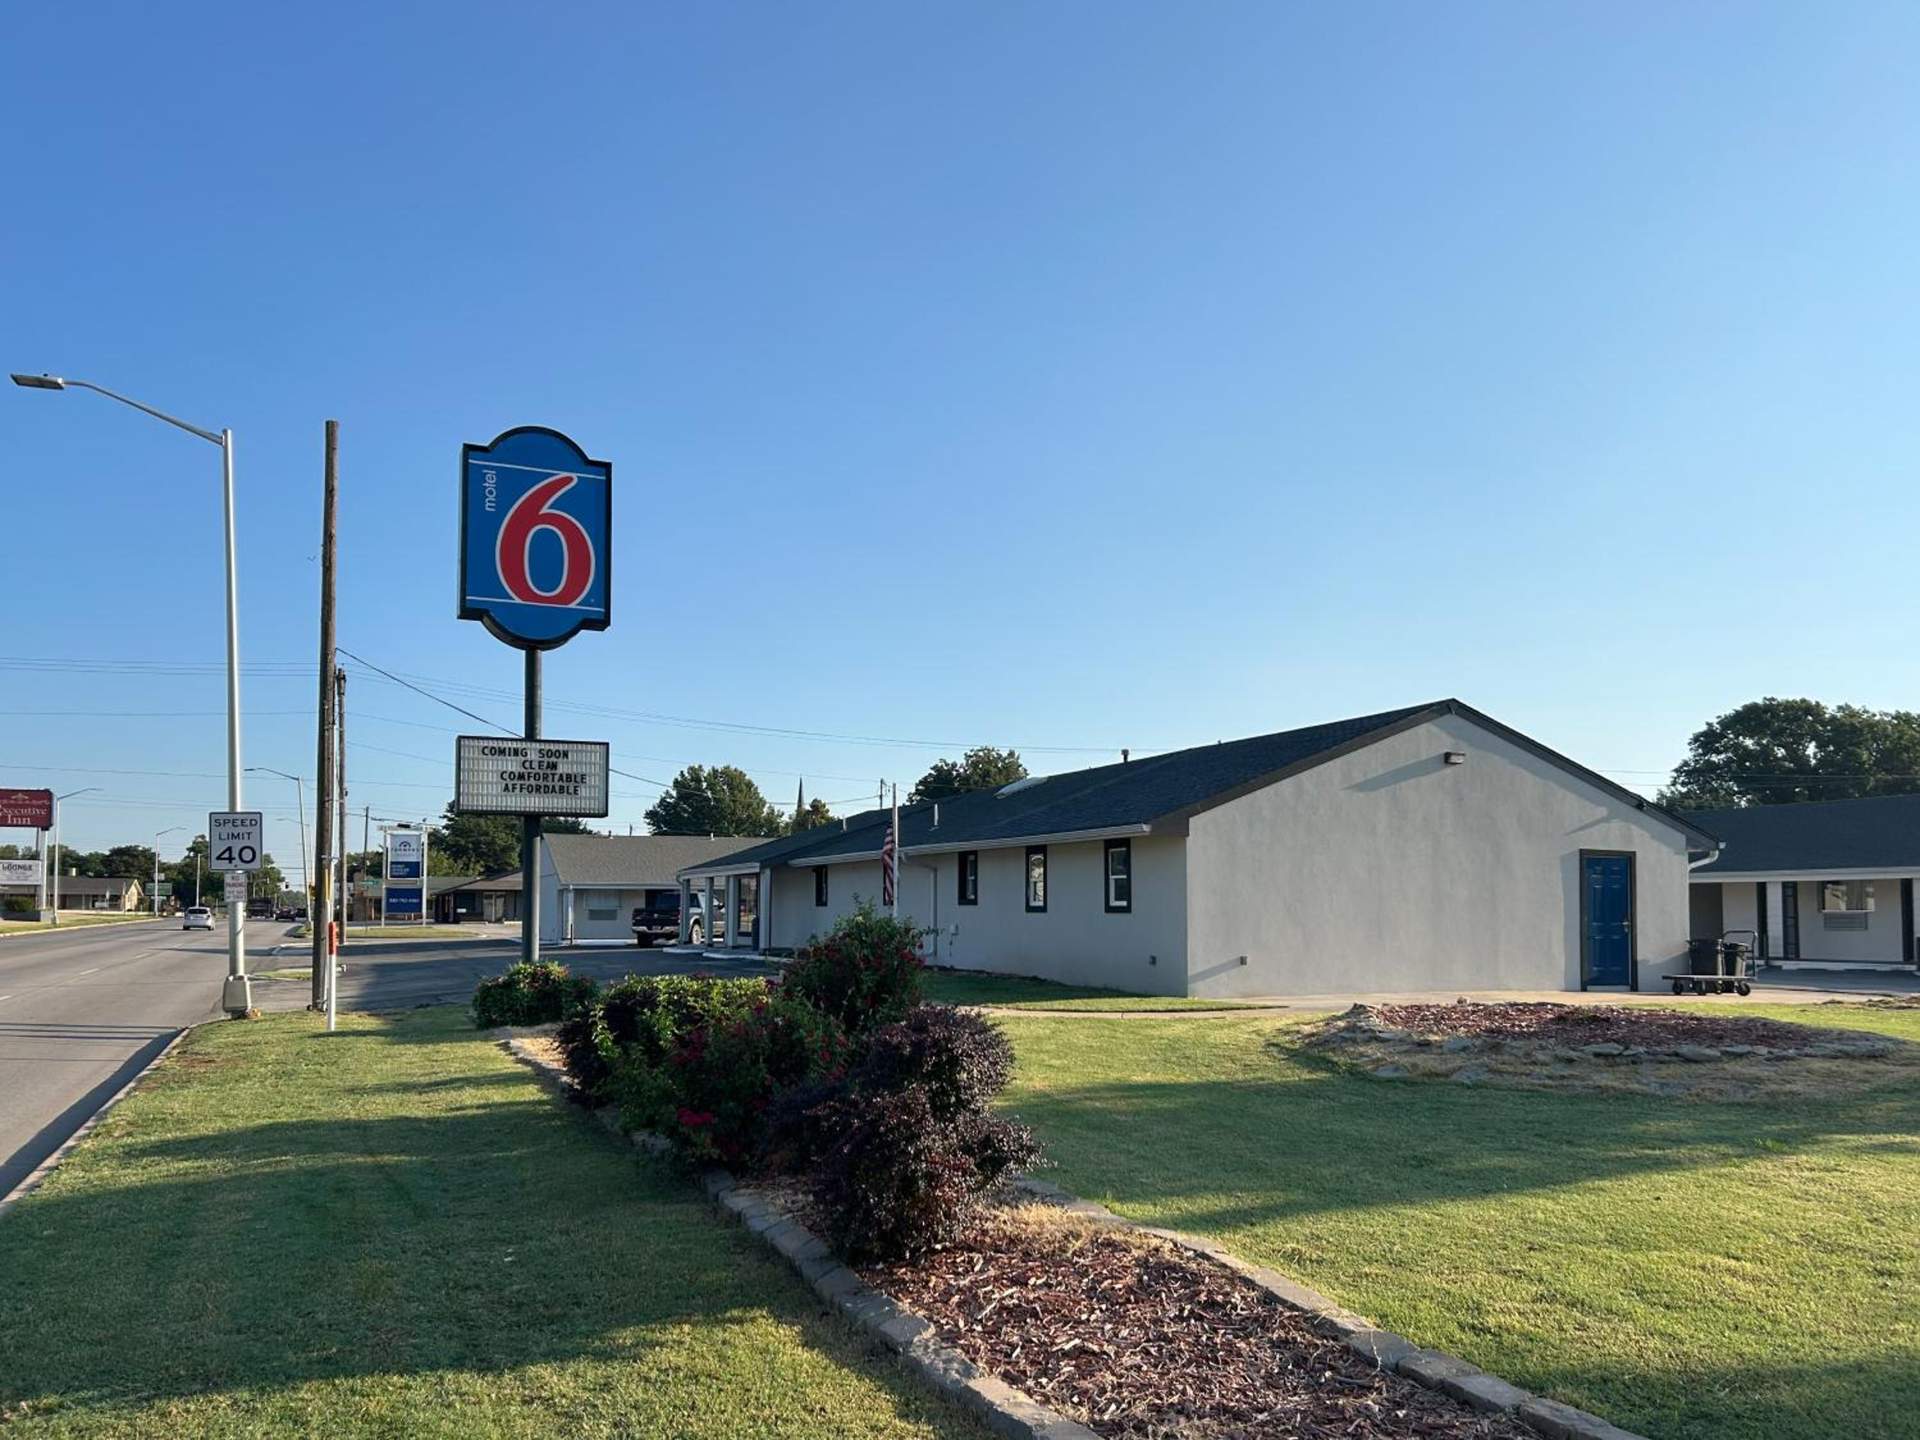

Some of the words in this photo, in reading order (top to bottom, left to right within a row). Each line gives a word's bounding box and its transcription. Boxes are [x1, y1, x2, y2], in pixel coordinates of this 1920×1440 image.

[483, 470, 497, 512] motel
[496, 474, 595, 606] 6
[481, 746, 528, 757] COMING
[538, 748, 569, 759] SOON
[522, 760, 558, 771] CLEAN
[500, 771, 587, 784] COMFORTABLE
[502, 783, 580, 795] AFFORDABLE
[8, 814, 31, 825] Inn
[214, 818, 258, 828] SPEED
[219, 832, 253, 841] LIMIT
[215, 845, 257, 864] 40
